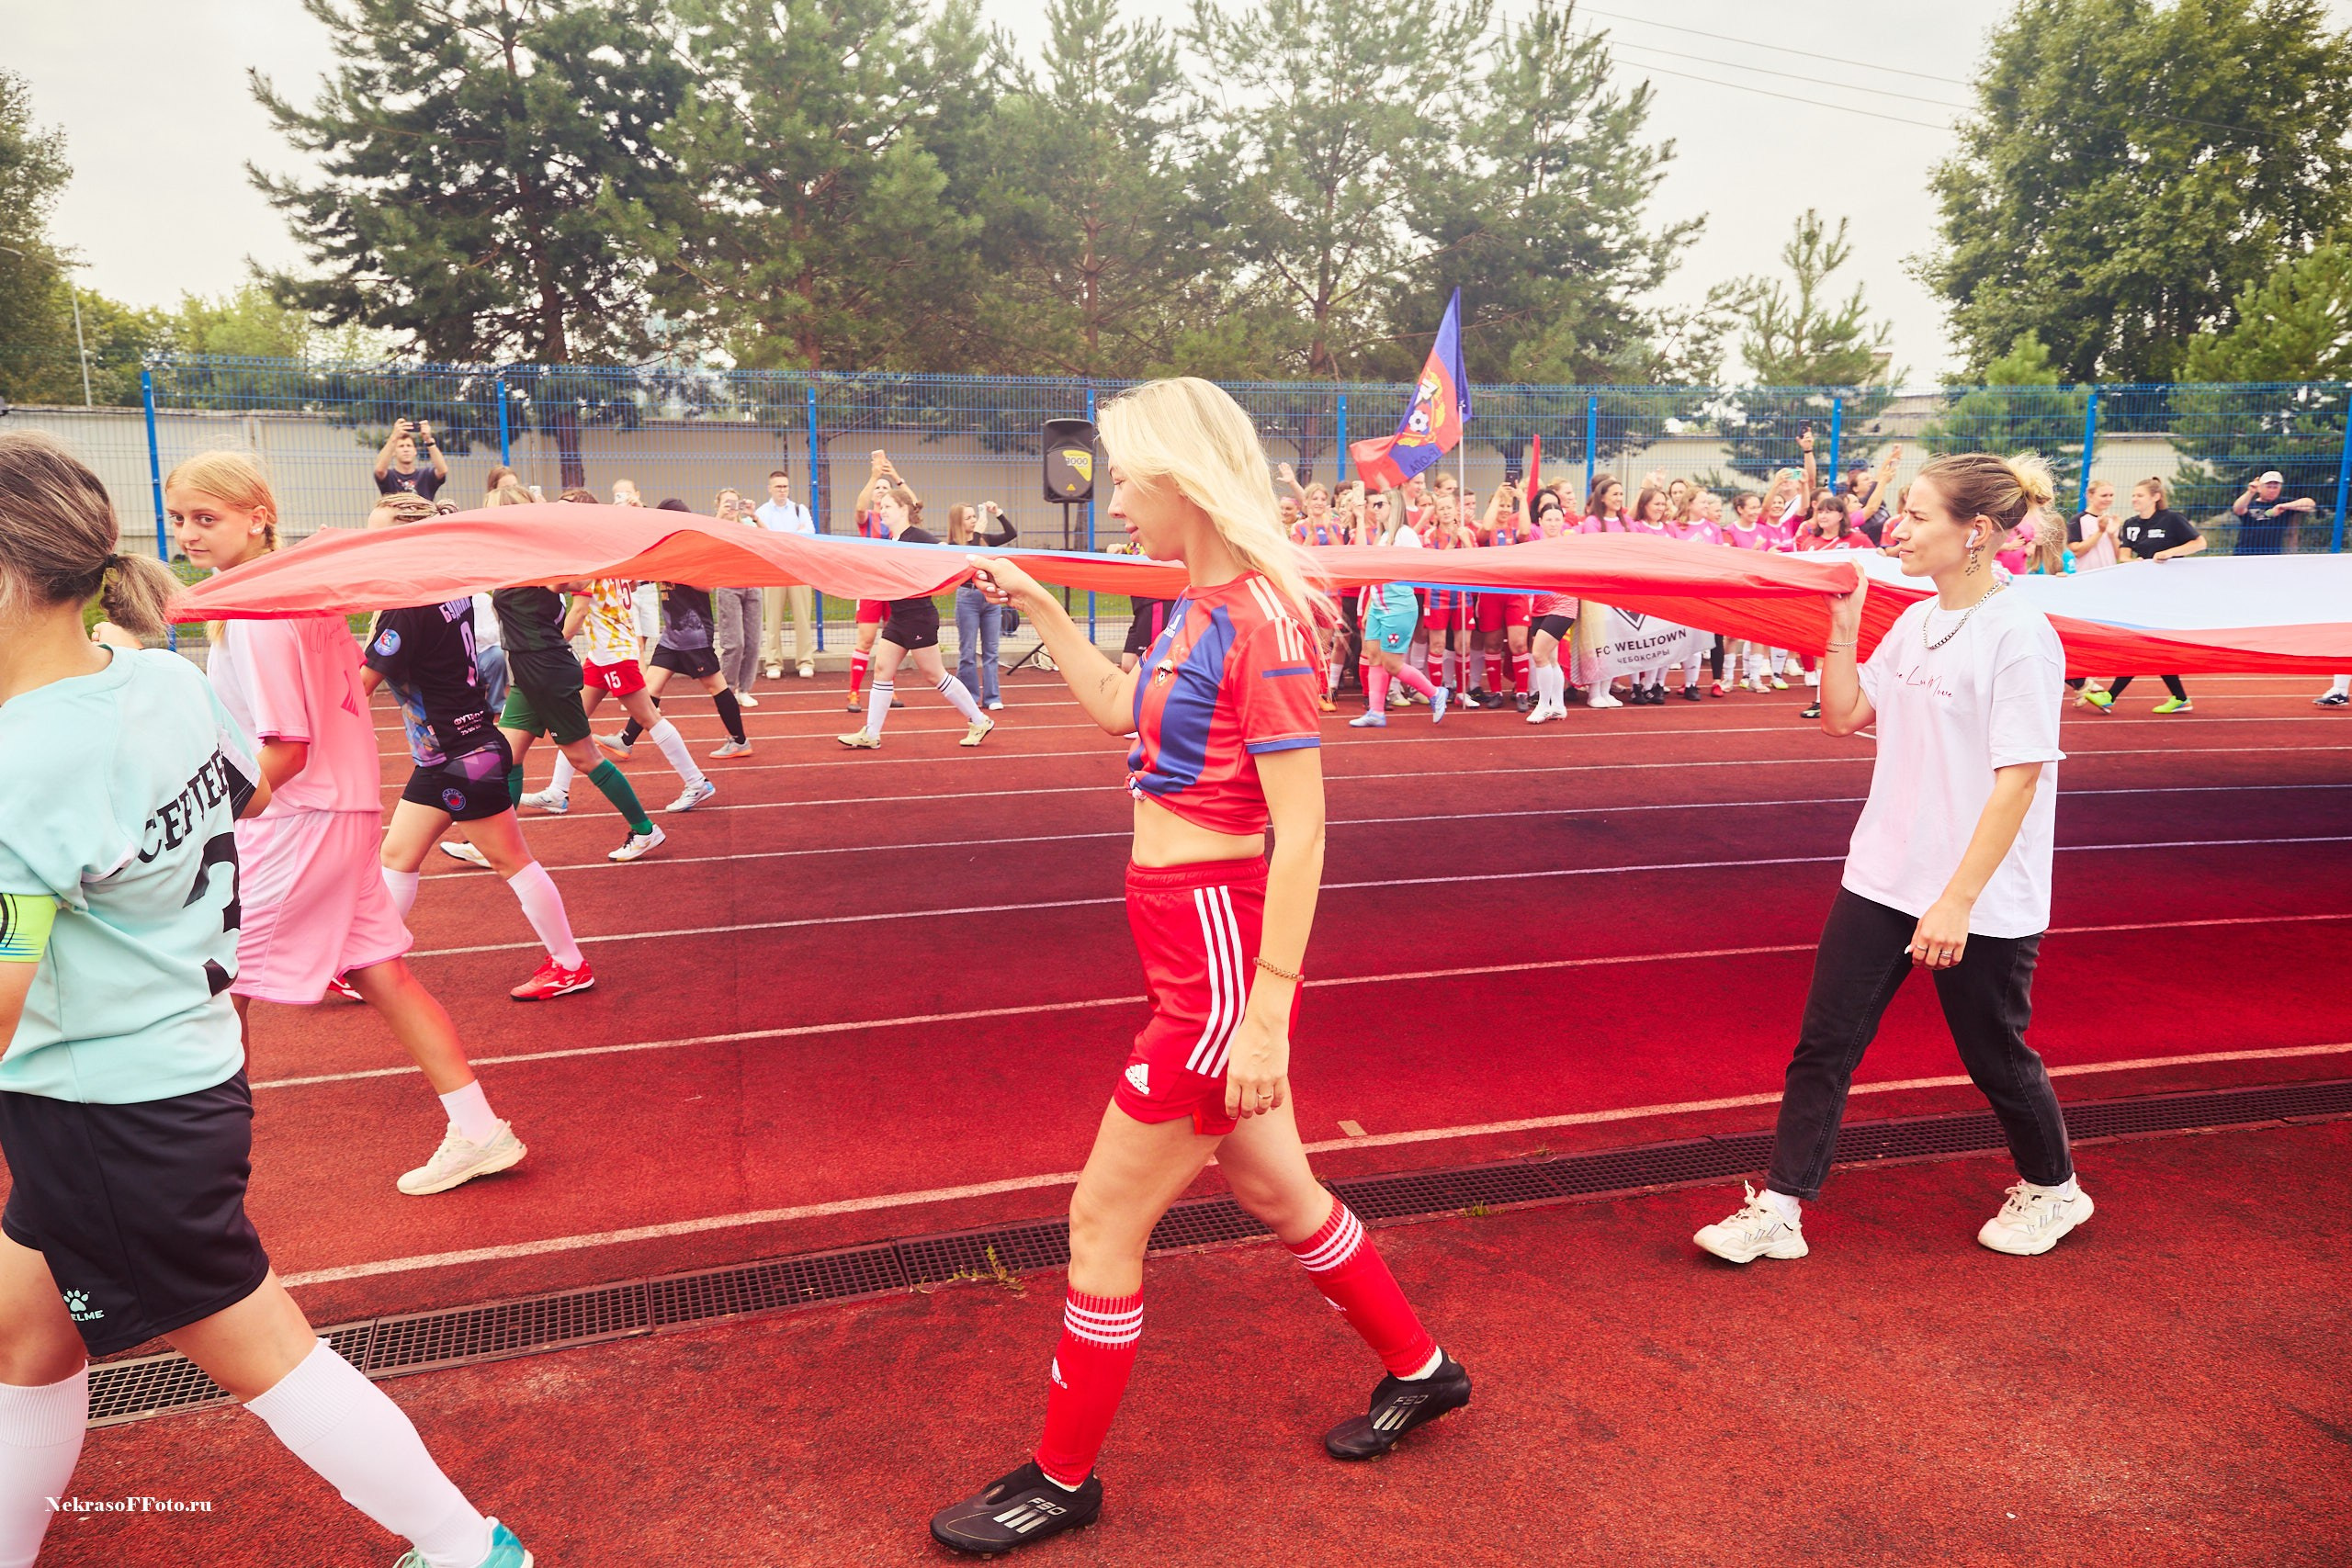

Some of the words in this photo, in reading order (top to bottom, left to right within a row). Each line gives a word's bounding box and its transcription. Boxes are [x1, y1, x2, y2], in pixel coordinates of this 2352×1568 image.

[1595, 645, 1611, 658] FC
[1614, 628, 1687, 652] WELLTOWN
[1617, 649, 1670, 664] ЧЕБОКСАРЫ
[604, 671, 622, 689] 15
[70, 1310, 105, 1321] ELME
